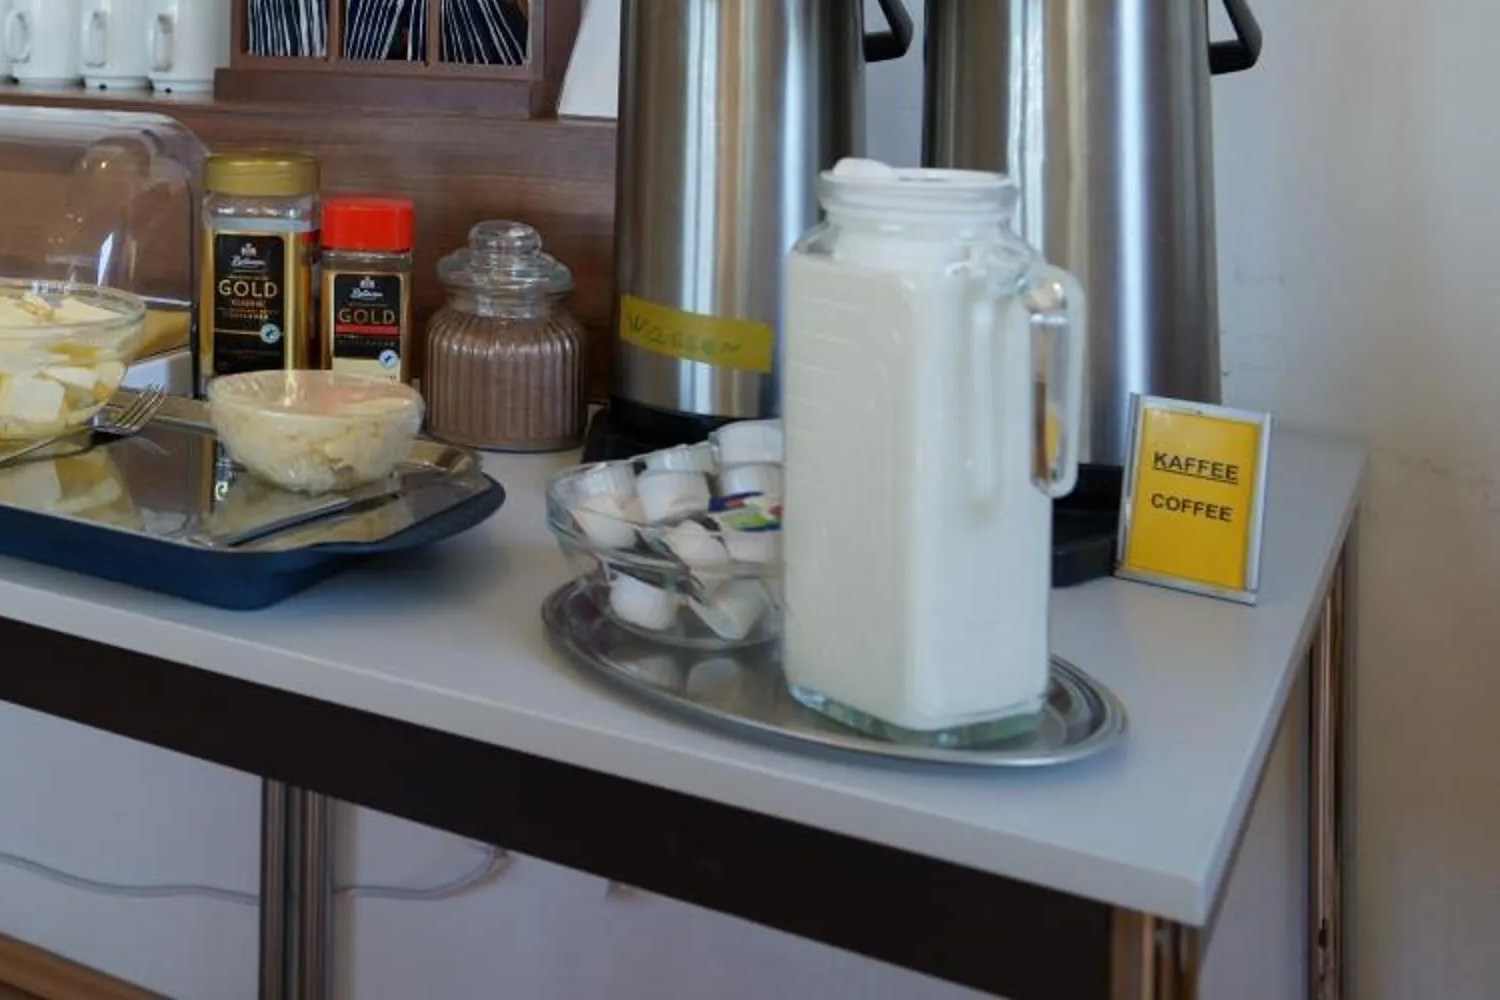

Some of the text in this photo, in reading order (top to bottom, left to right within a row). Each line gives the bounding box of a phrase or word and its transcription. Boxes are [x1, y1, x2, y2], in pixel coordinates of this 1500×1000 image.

[217, 278, 279, 299] GOLD
[338, 307, 396, 326] GOLD
[1152, 450, 1240, 483] KAFFEE
[1150, 492, 1234, 523] COFFEE
